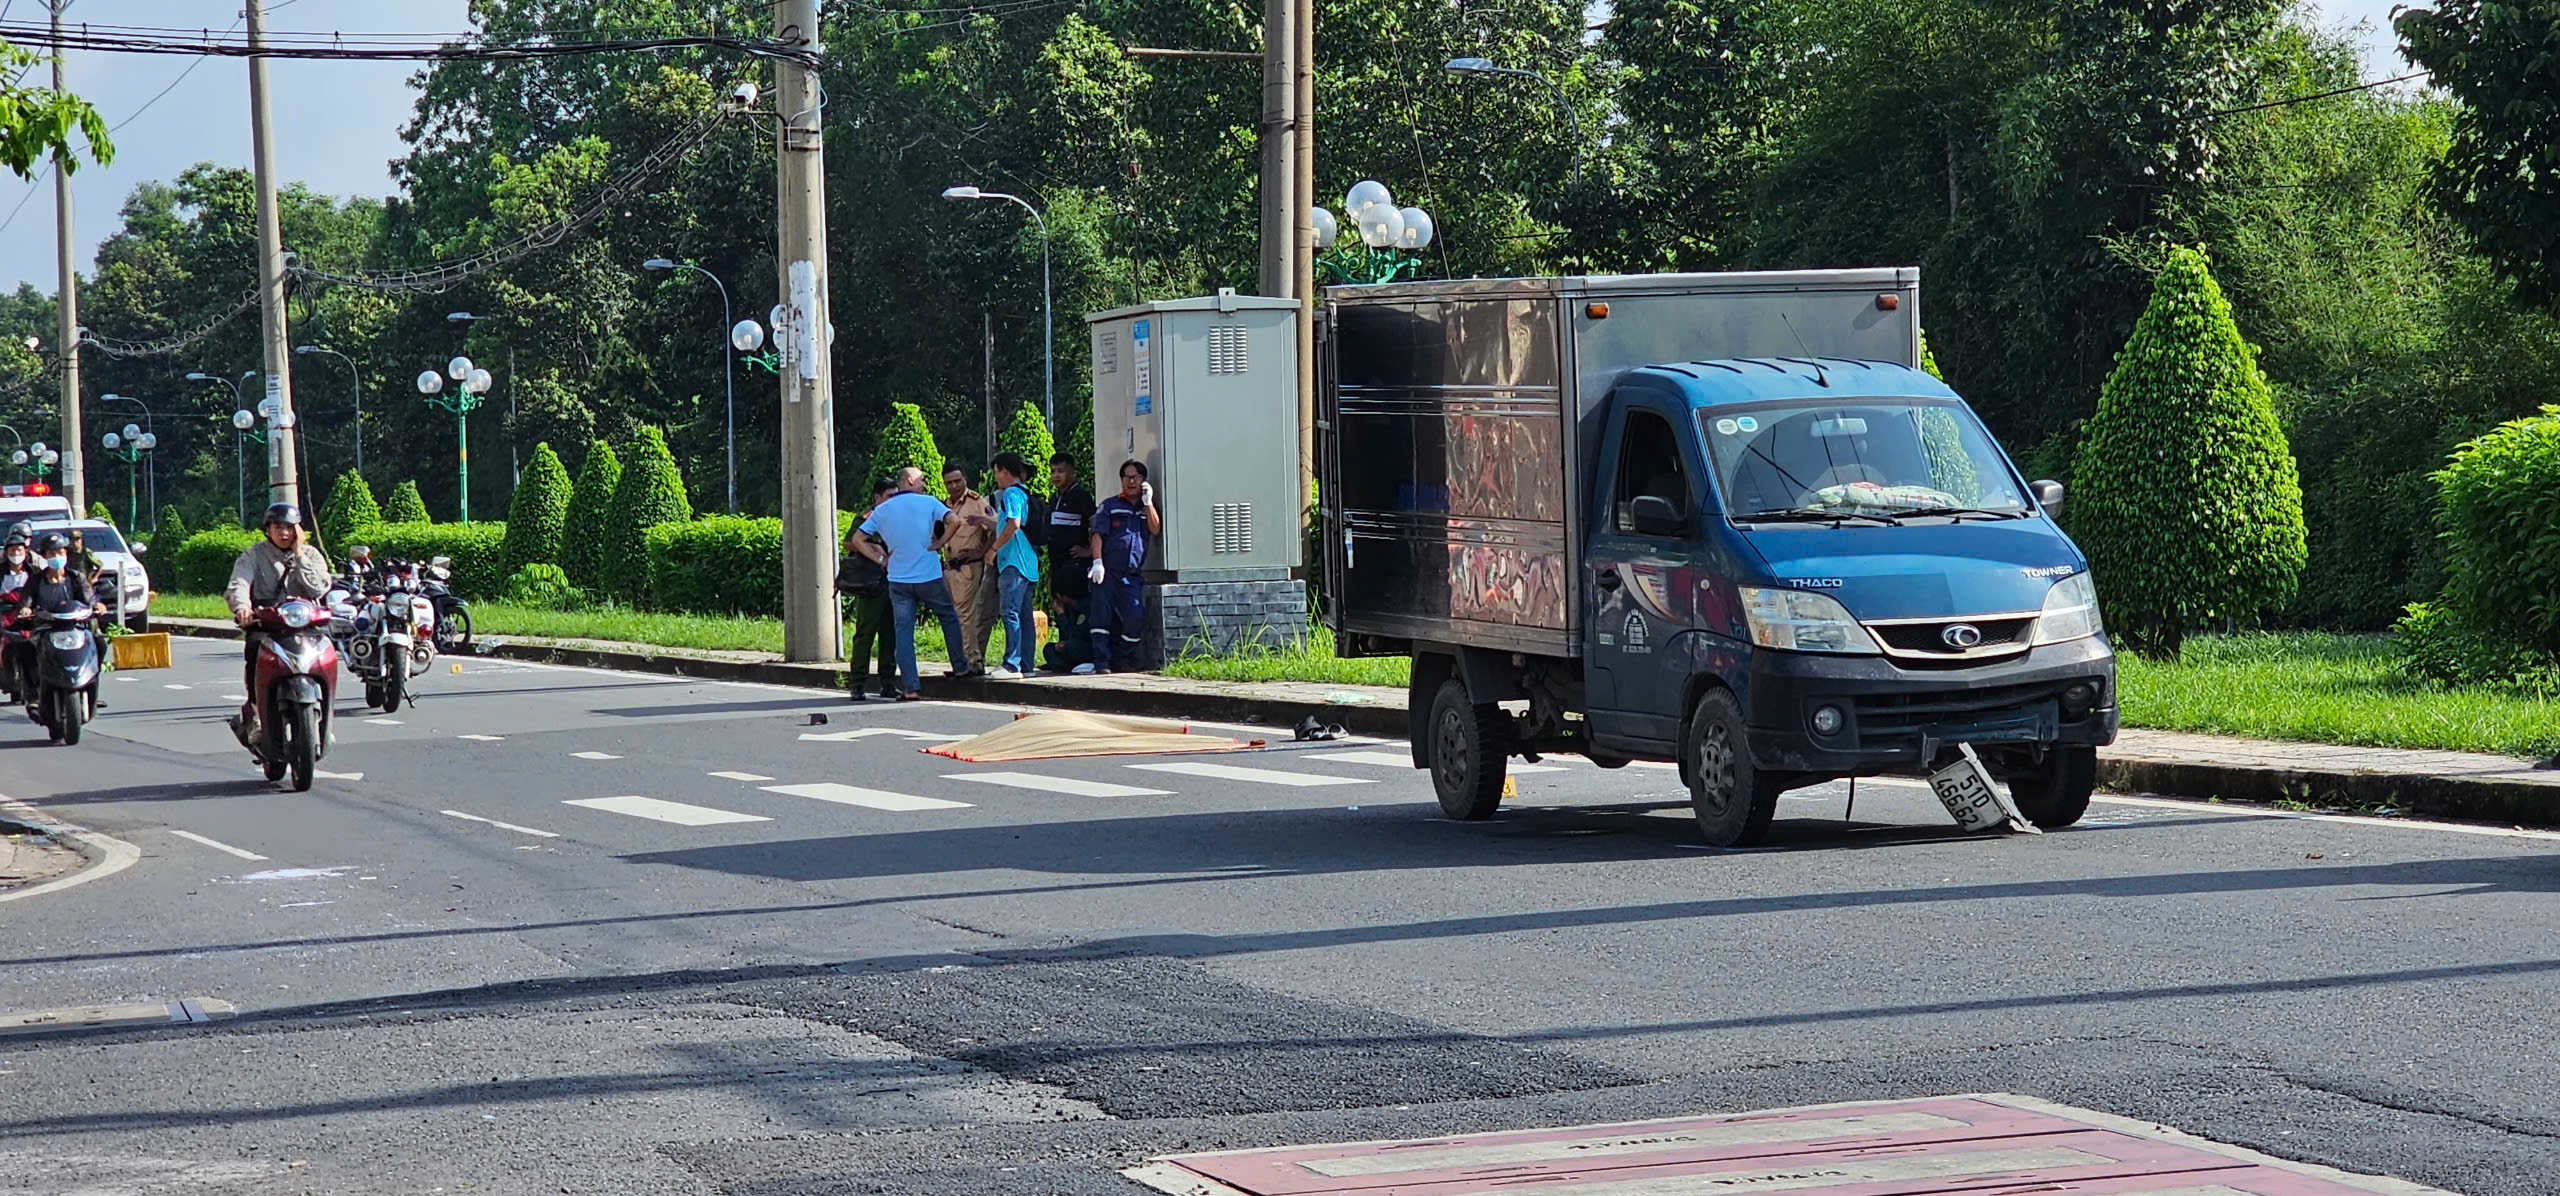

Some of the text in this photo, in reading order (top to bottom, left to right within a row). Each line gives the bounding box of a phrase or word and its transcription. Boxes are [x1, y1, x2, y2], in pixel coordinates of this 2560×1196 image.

[1789, 578, 1843, 588] THACO
[2021, 565, 2074, 578] TOWNER
[1936, 778, 1979, 827] 466.62
[1960, 774, 1990, 808] 51D
